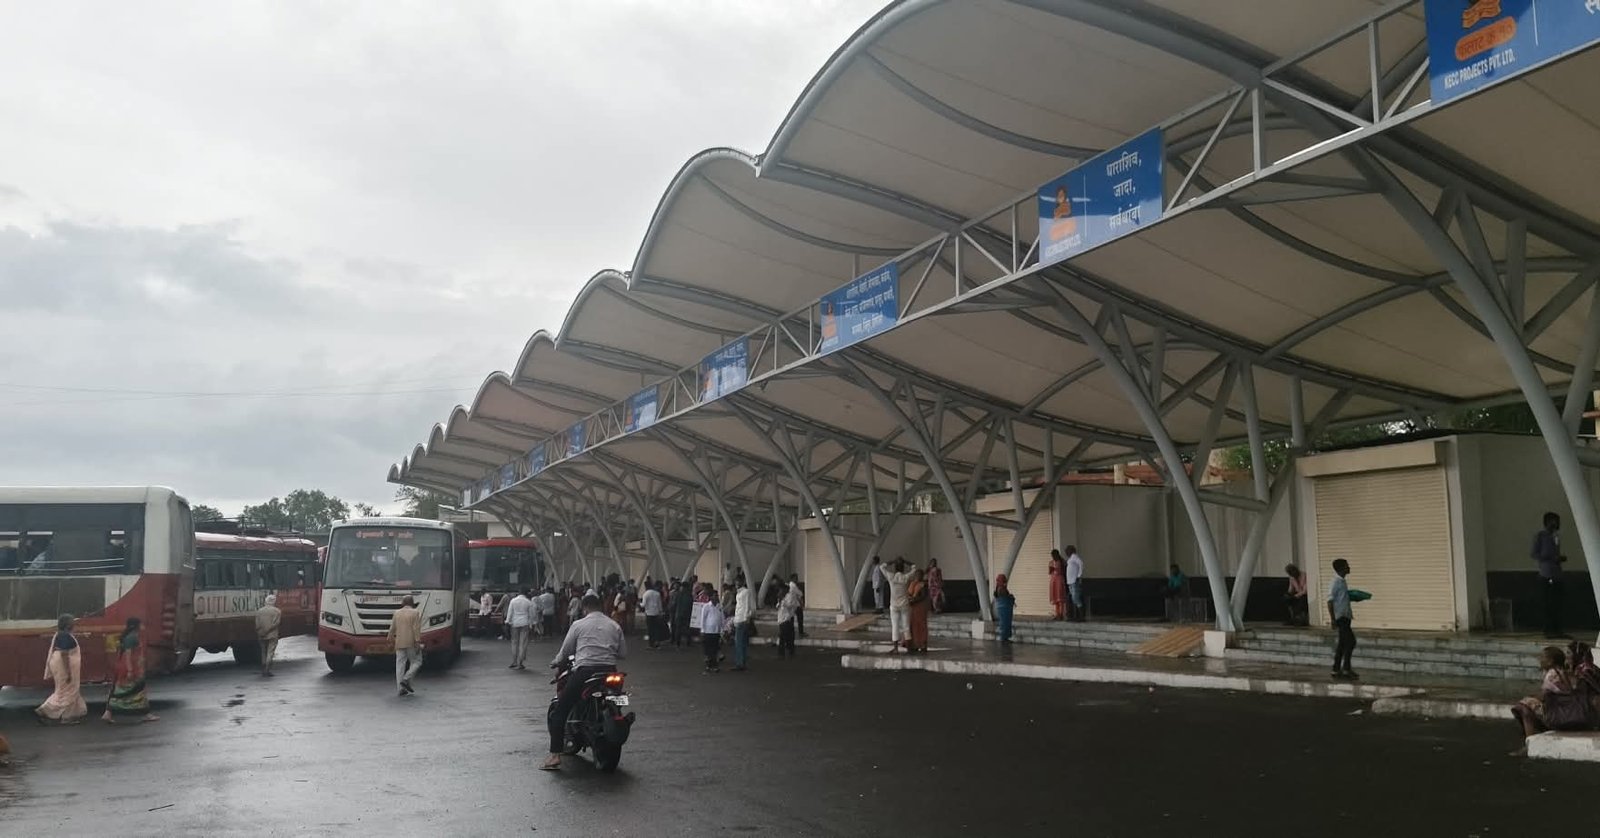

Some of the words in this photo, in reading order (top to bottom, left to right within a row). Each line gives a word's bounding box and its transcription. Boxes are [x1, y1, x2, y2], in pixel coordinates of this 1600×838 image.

[1444, 71, 1459, 89] KECC
[1460, 58, 1489, 83] PROJECTS
[1489, 53, 1502, 71] PVT.
[1502, 48, 1516, 66] LTD.
